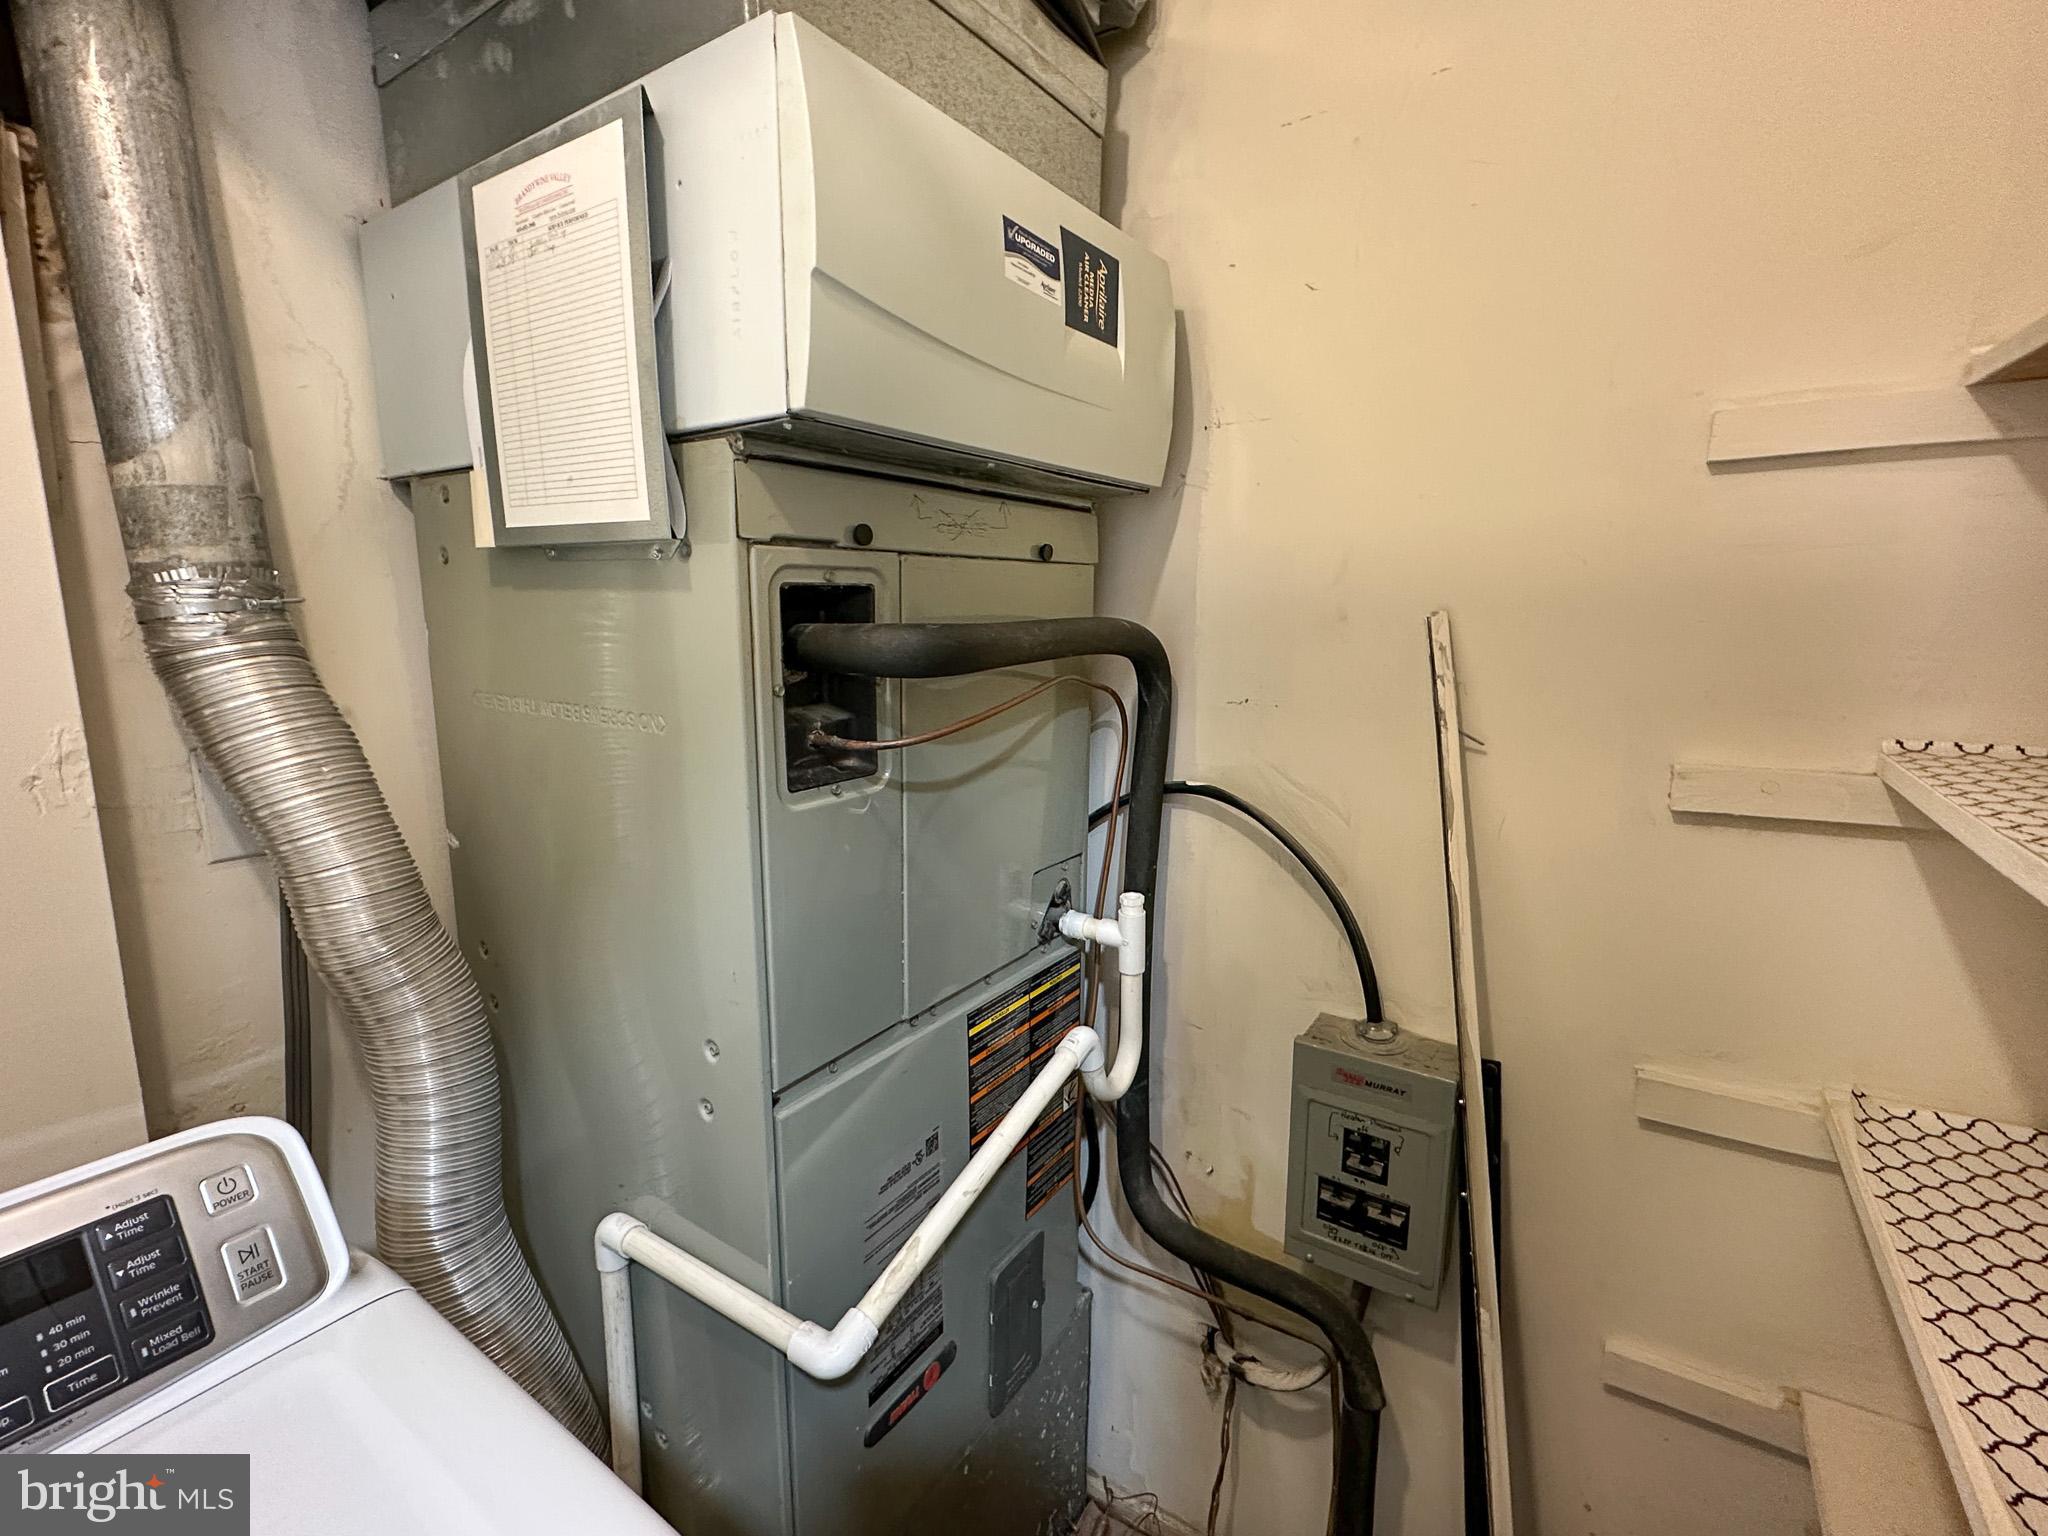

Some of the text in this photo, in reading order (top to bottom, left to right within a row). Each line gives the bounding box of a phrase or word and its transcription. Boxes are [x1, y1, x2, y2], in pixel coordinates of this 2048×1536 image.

[1014, 234, 1056, 263] UPGRADED
[1098, 258, 1108, 331] Aprilaire
[1365, 1080, 1408, 1097] MURRAY
[213, 1189, 250, 1210] POWER
[114, 1211, 149, 1232] Adjust
[117, 1223, 145, 1241] Time
[126, 1248, 162, 1270] Adjust
[129, 1260, 156, 1278] Time
[237, 1259, 270, 1280] START
[240, 1270, 274, 1291] PAUSE
[138, 1282, 181, 1308] Wrinkle
[140, 1292, 184, 1318] Prevent
[48, 1314, 86, 1336] 40 min
[149, 1324, 184, 1347] Mixed
[52, 1328, 91, 1351] 30 min
[152, 1325, 201, 1357] Load Bell
[57, 1343, 96, 1367] 20 min
[67, 1373, 98, 1392] Time
